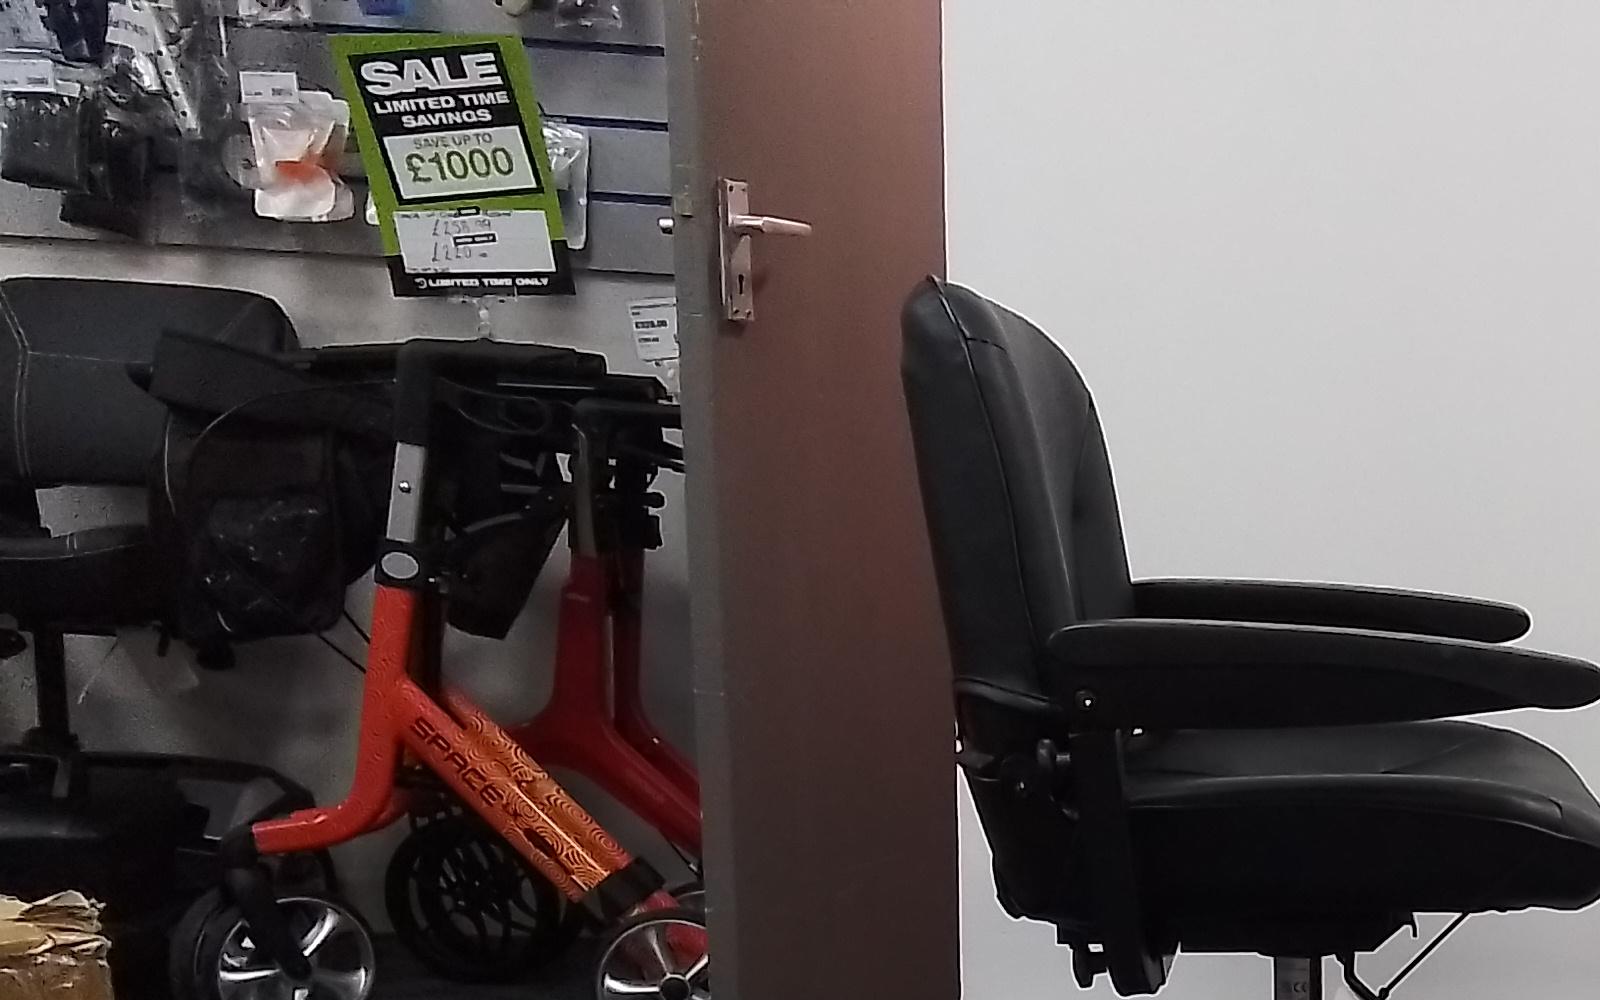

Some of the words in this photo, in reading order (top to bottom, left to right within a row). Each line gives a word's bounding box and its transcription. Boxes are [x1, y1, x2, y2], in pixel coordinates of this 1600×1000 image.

[360, 52, 504, 96] SALE
[374, 96, 455, 114] LIMITED
[459, 91, 510, 106] TIME
[401, 108, 492, 128] SAVINGS
[413, 135, 449, 150] SAVE
[452, 135, 472, 148] UP
[475, 133, 493, 145] TO
[405, 147, 514, 183] £1000
[428, 277, 480, 287] LIMITED
[481, 277, 512, 287] TIME
[515, 276, 549, 286] ONLY
[410, 716, 504, 808] SPACE
